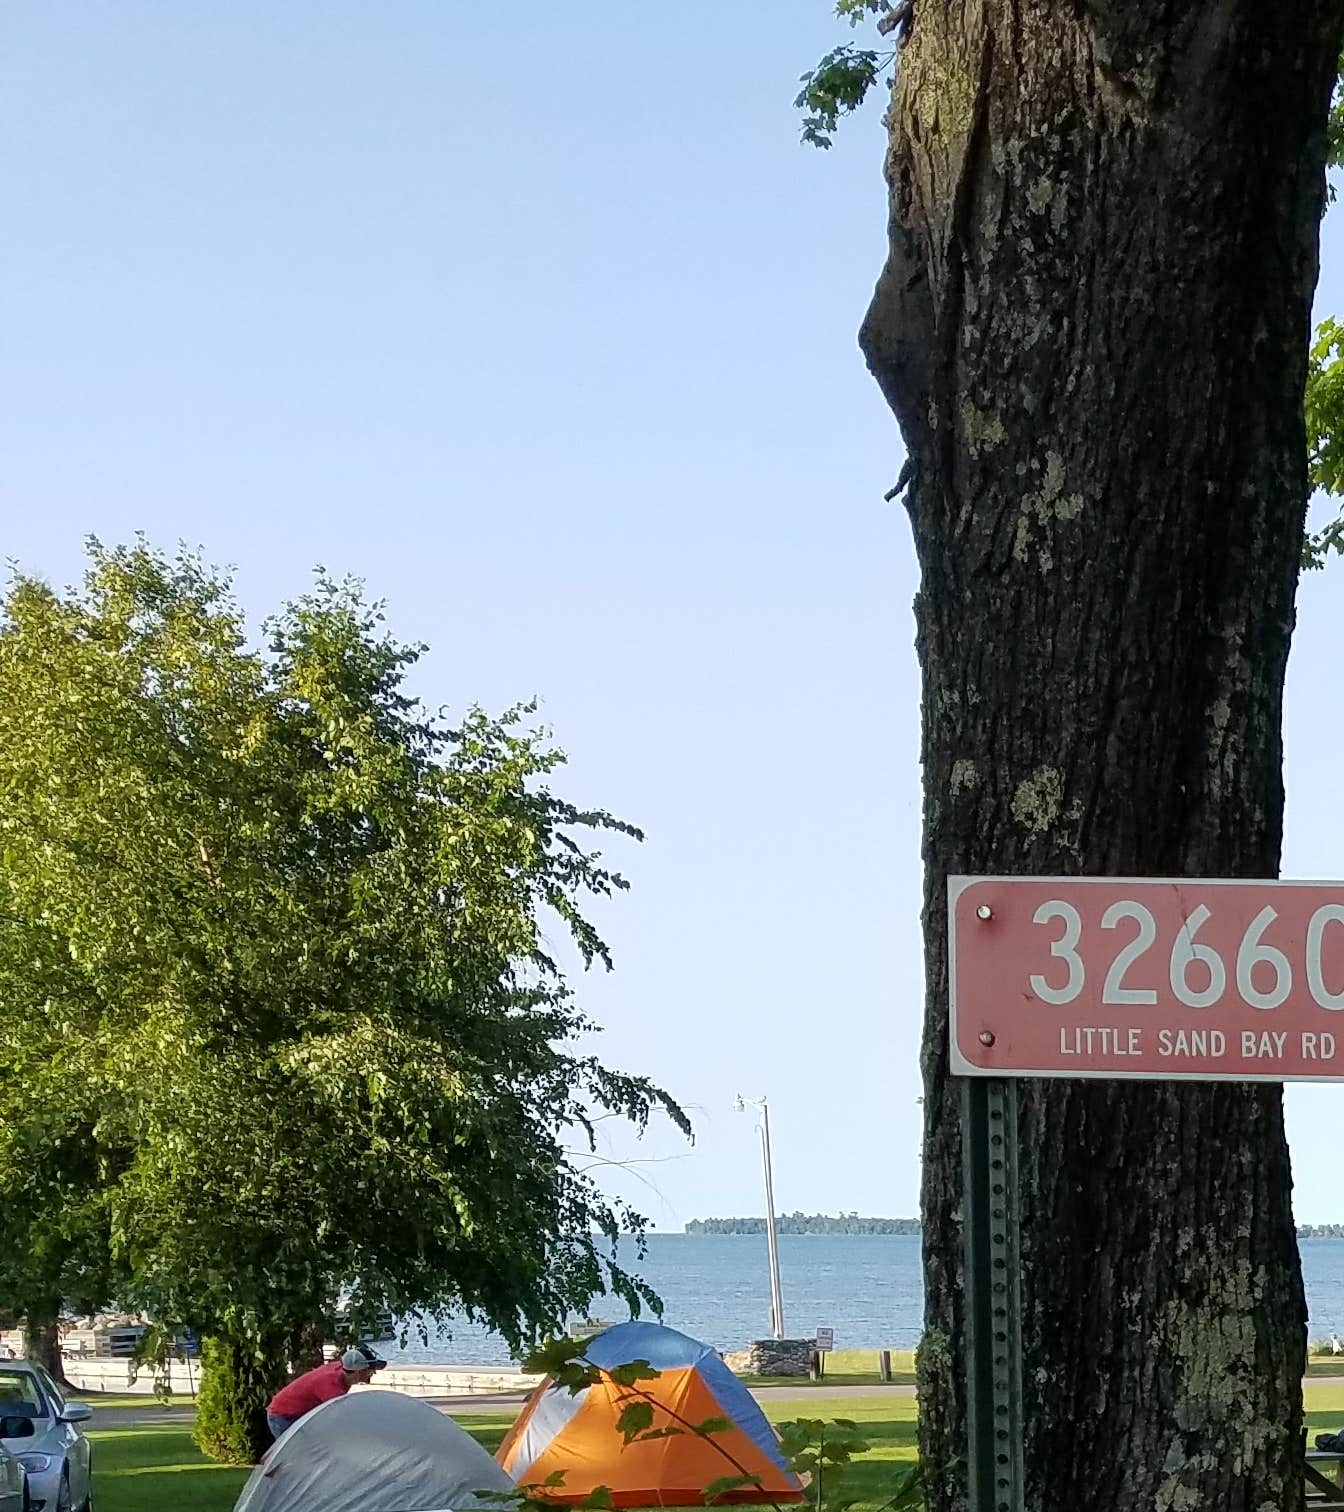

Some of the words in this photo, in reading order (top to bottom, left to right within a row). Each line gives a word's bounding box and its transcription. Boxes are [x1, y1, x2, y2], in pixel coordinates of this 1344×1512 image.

[1059, 1027, 1143, 1056] LITTLE
[1157, 1029, 1226, 1058] SAND
[1240, 1031, 1289, 1058] BAY
[1301, 1032, 1337, 1060] RD
